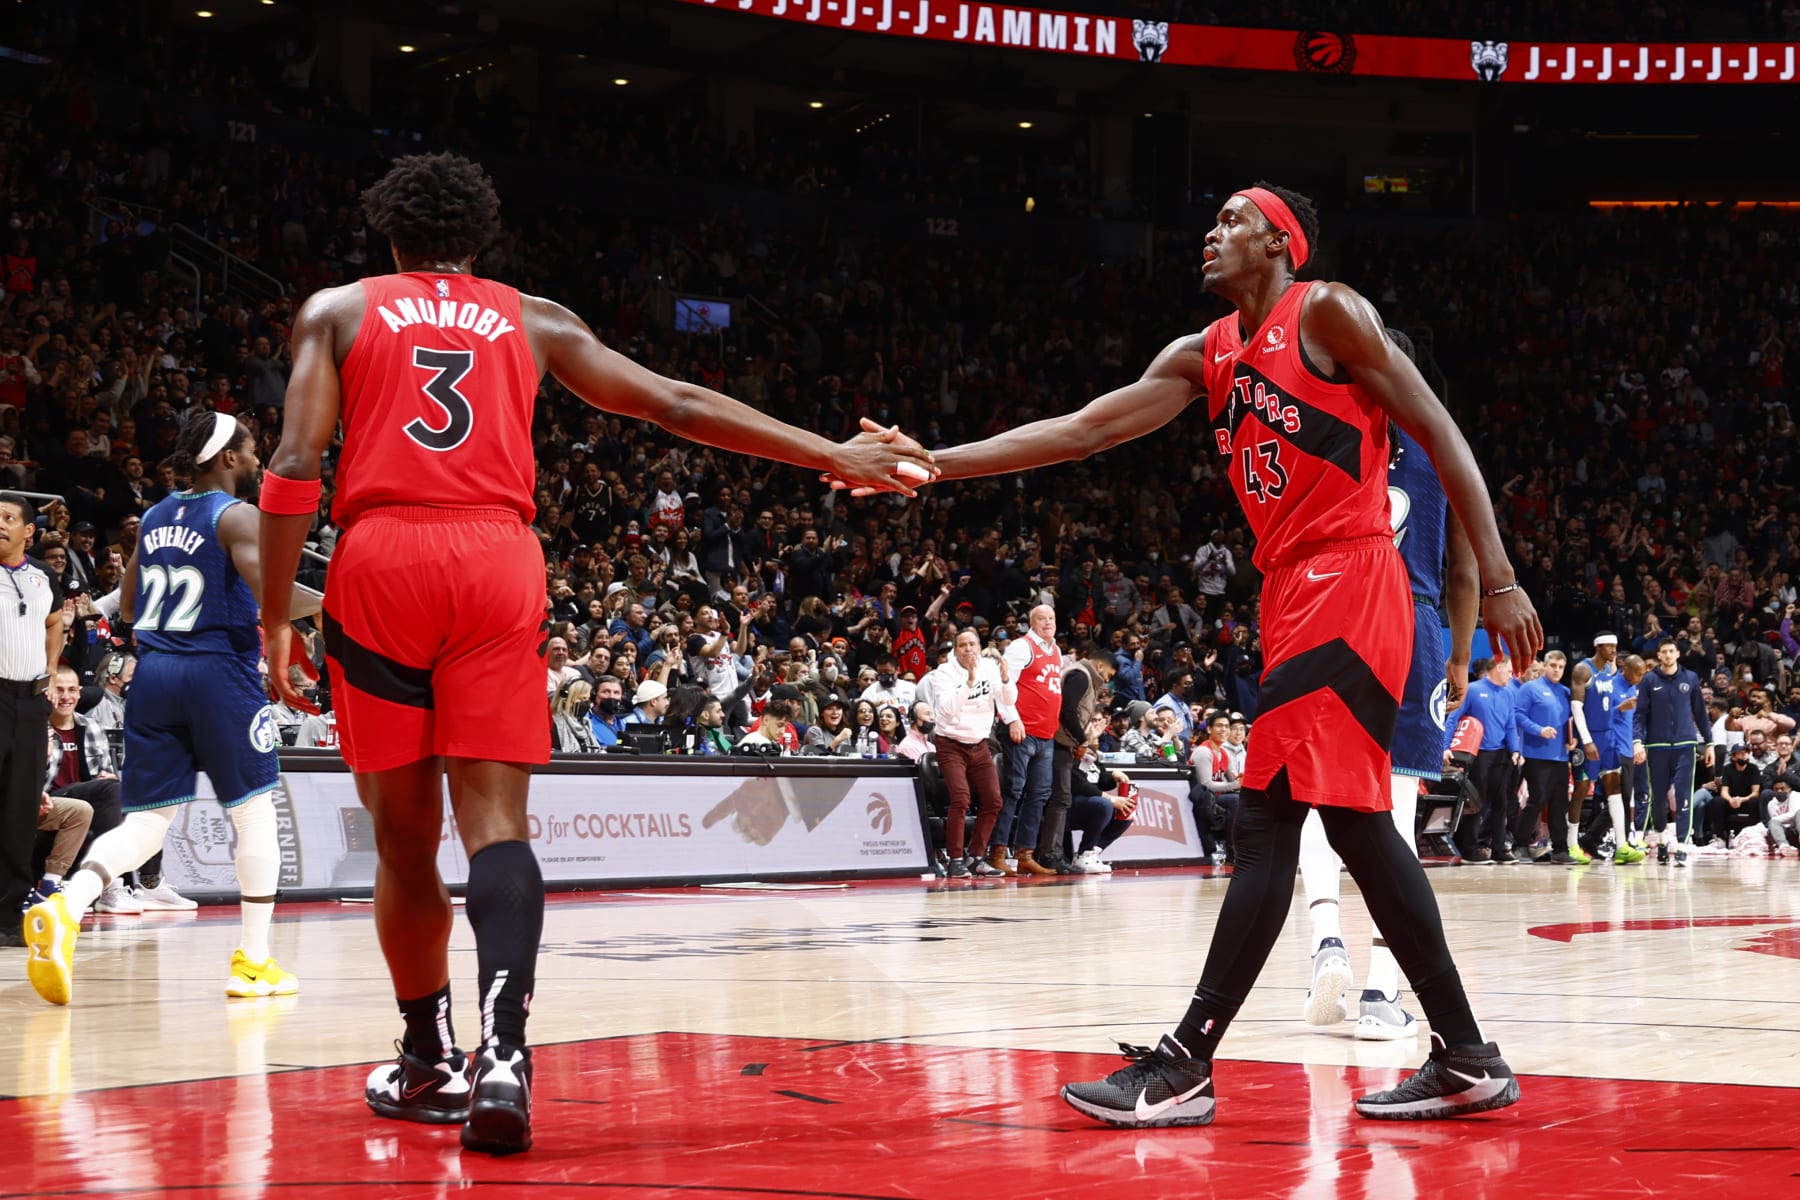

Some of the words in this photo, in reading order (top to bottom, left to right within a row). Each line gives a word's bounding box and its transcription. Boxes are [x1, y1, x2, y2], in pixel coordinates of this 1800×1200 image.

[227, 120, 256, 143] 121
[926, 217, 958, 236] 122
[377, 297, 516, 342] ANUNOBY
[1262, 347, 1275, 355] Sun
[402, 345, 474, 452] 3
[1215, 376, 1301, 456] RTORS
[1242, 438, 1288, 504] 43
[588, 509, 597, 521] 7
[143, 525, 206, 555] BEVERLEY
[132, 564, 205, 632] 22
[911, 652, 920, 666] 4
[1035, 663, 1062, 683] RAPTO
[199, 809, 213, 854] VODKA
[546, 814, 570, 845] for
[573, 812, 692, 839] COCKTAILS
